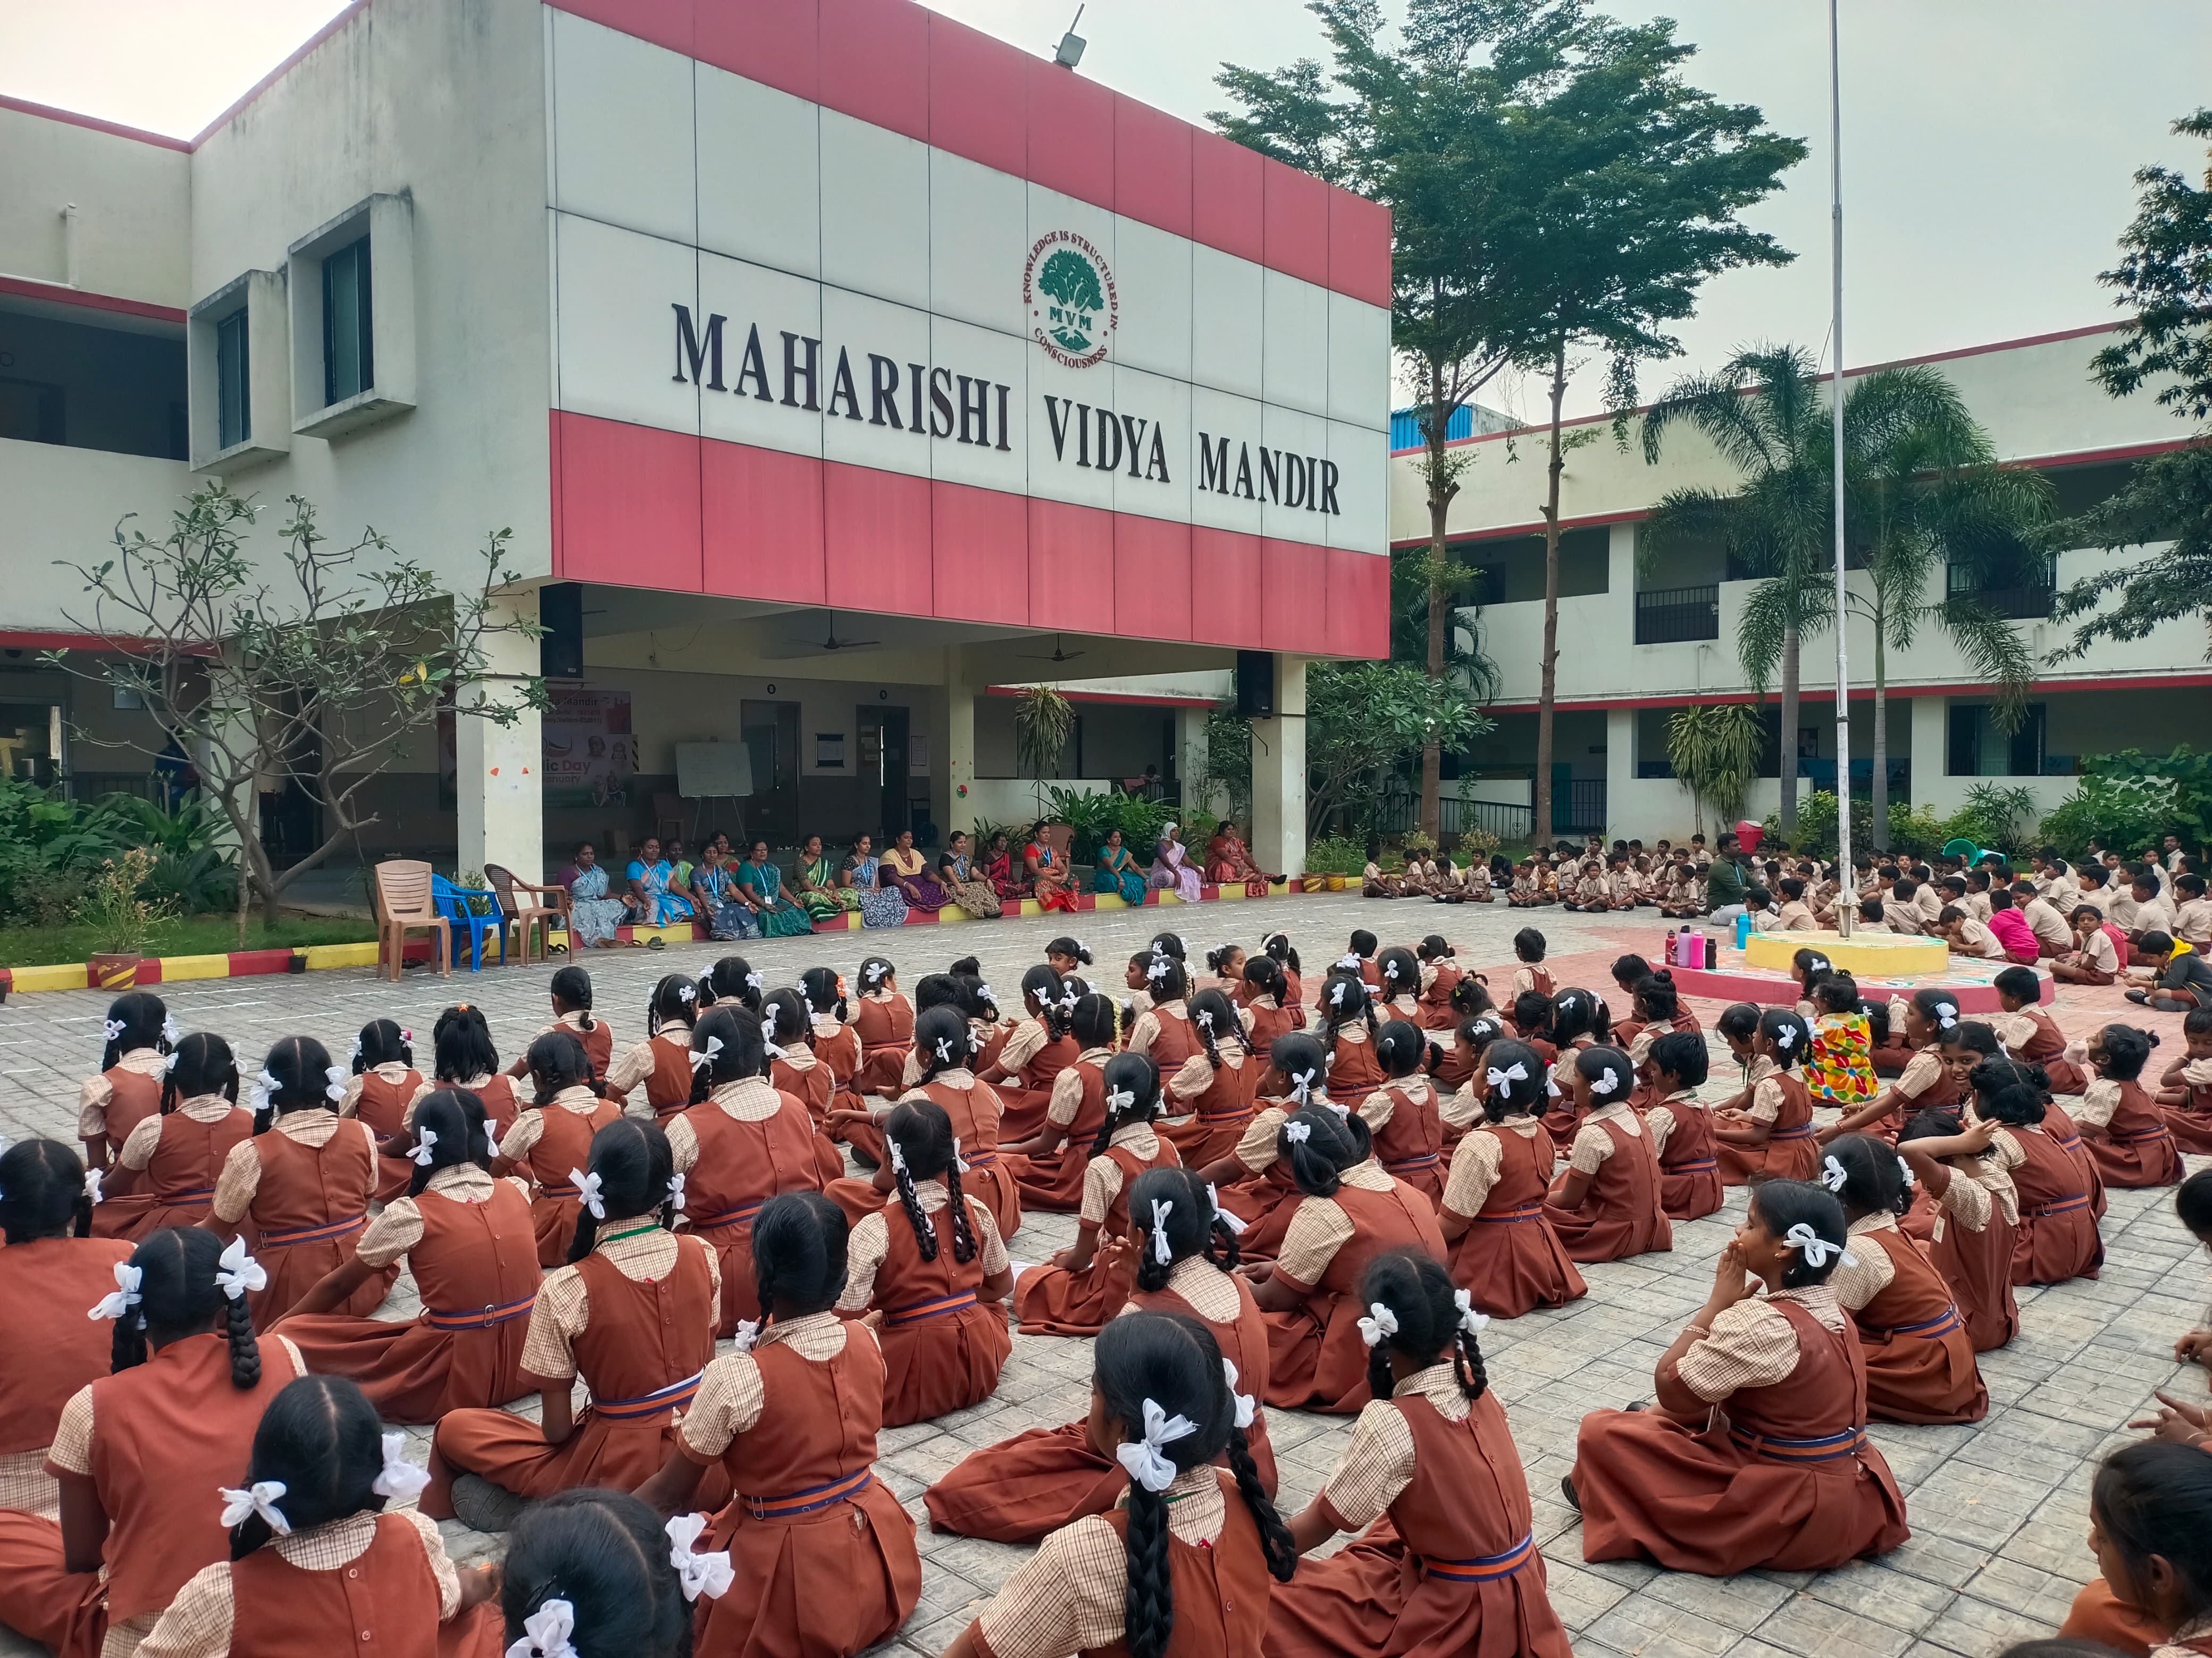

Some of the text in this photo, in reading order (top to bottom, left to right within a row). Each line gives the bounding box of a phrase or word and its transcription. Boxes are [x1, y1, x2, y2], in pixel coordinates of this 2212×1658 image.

[1023, 230, 1118, 330] KNOWLEDGE IS STRUCTURED IN
[1034, 327, 1107, 368] CONSCIOUSNESS
[672, 303, 1340, 515] MAHARISHI VIDYA MANDIR
[564, 696, 598, 706] Mandir
[562, 760, 591, 775] Day
